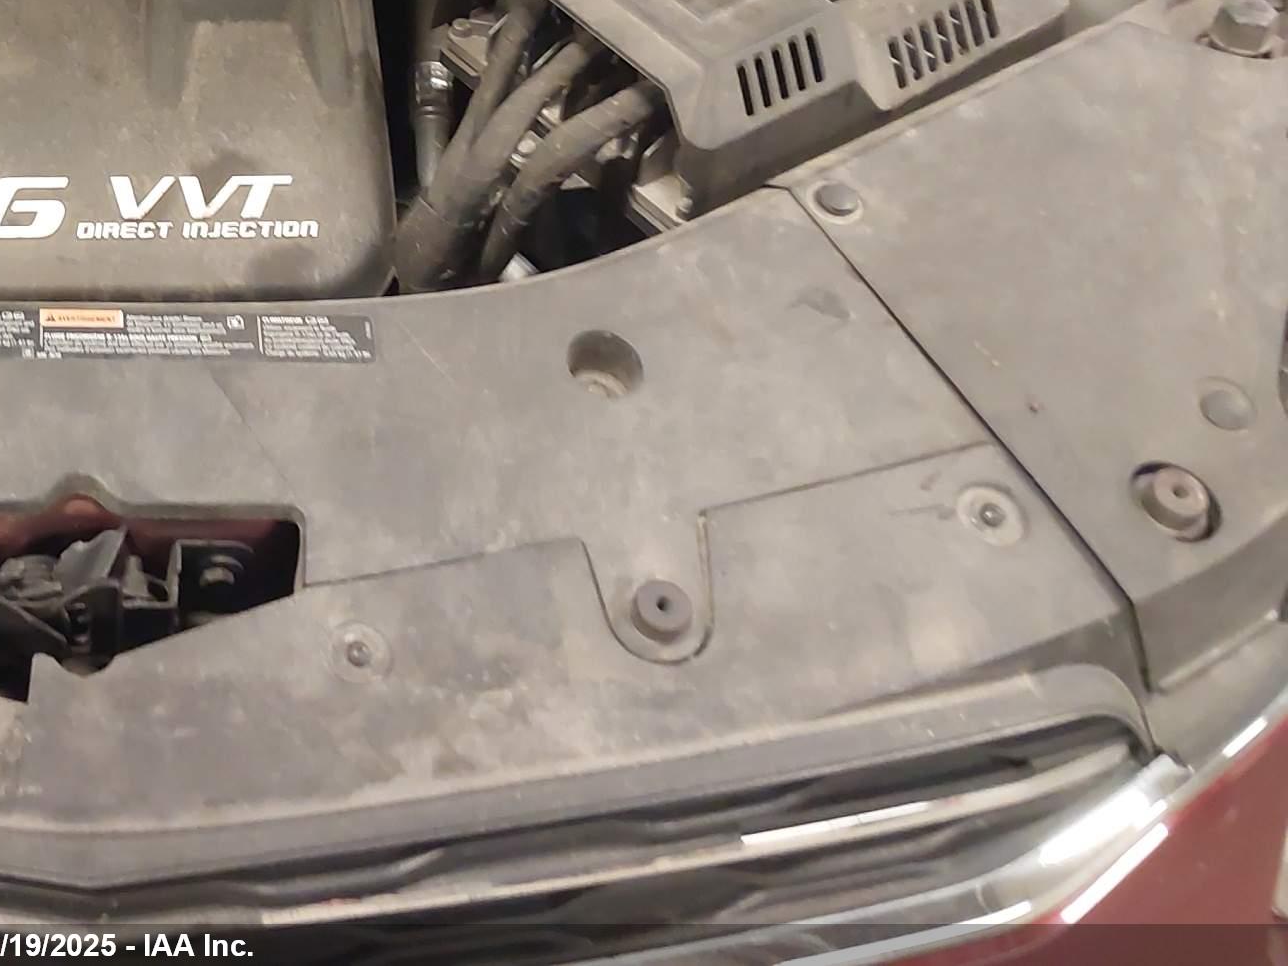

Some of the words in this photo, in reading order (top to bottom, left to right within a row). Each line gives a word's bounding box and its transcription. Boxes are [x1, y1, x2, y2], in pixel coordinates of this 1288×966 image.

[110, 174, 294, 220] VVT
[75, 220, 175, 241] DIRECT
[181, 219, 320, 240] INJECTION
